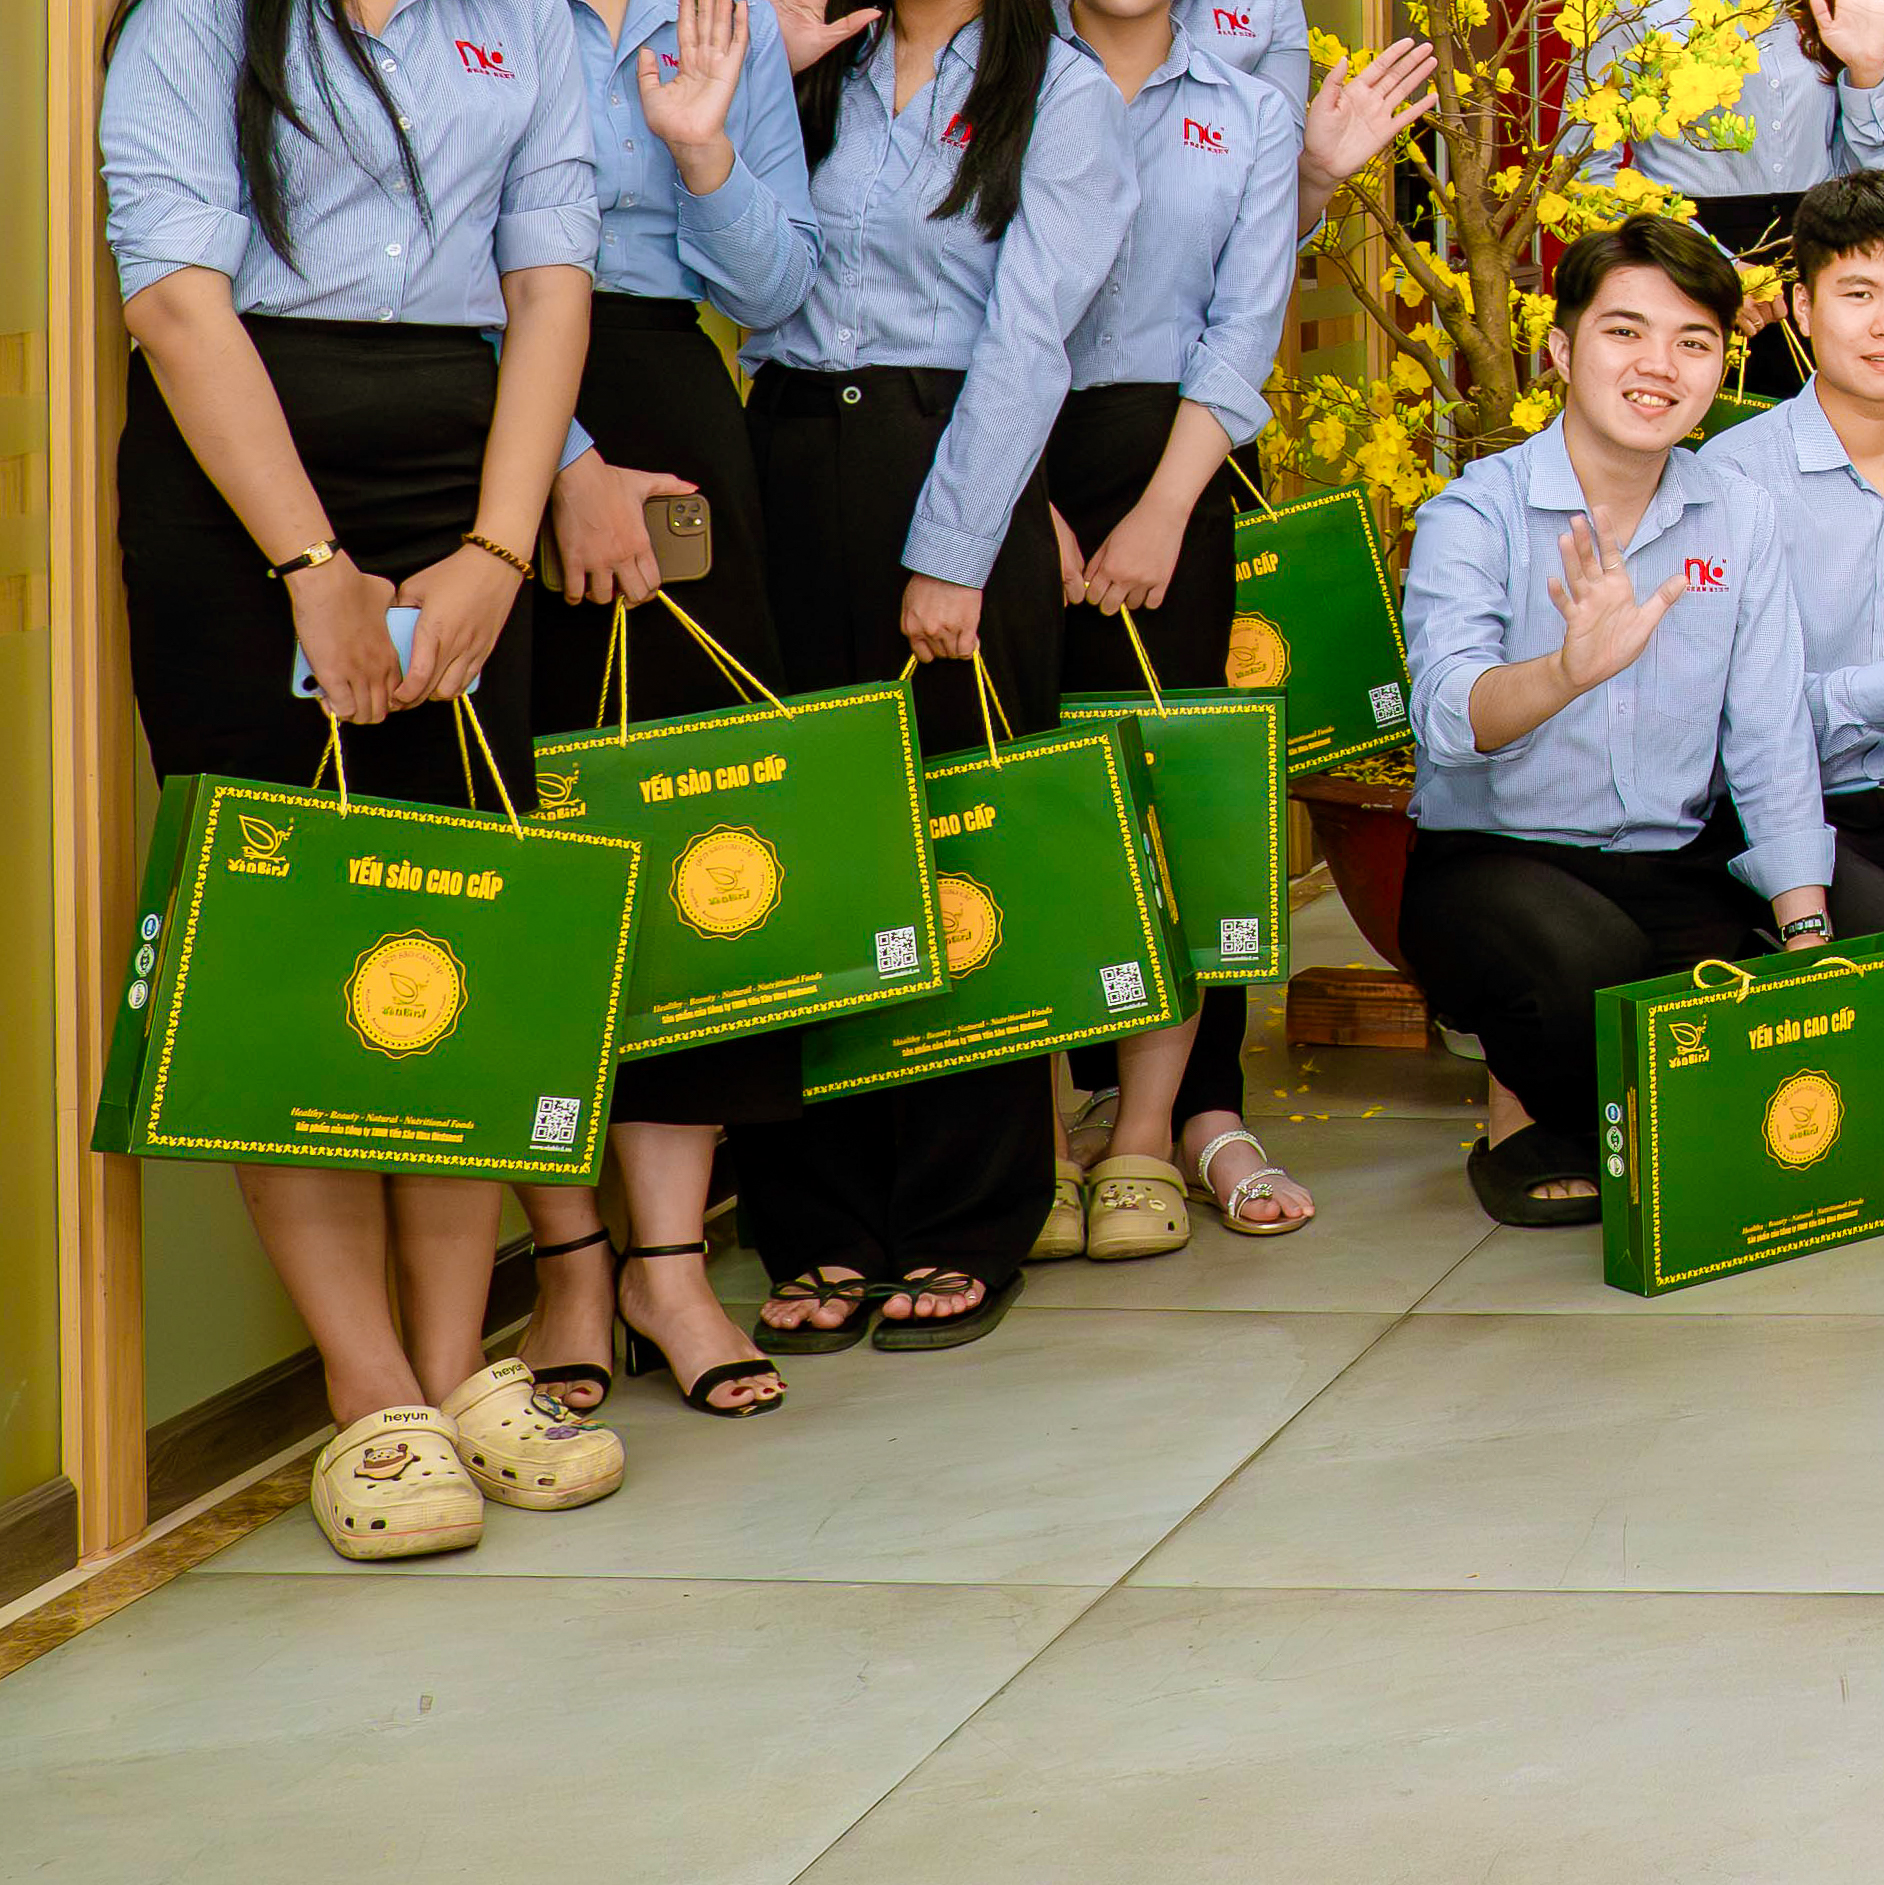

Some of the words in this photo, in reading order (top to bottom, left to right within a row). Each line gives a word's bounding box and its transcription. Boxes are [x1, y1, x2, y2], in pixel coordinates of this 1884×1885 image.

[1236, 561, 1252, 583] AO
[1253, 551, 1279, 576] CẤP
[639, 772, 674, 804] YẾN
[677, 767, 712, 798] SÀO
[715, 764, 751, 793] CAO
[753, 754, 787, 784] CẤP
[963, 803, 997, 830] CẤP
[349, 856, 383, 887] YẾN
[385, 859, 423, 892] SÀO
[426, 868, 463, 896] CAO
[466, 870, 504, 901] CẤP
[1749, 1023, 1773, 1050] YẾN
[1775, 1018, 1800, 1045] SÀO
[1803, 1014, 1828, 1039] CAO
[1831, 1006, 1855, 1032] CẤP
